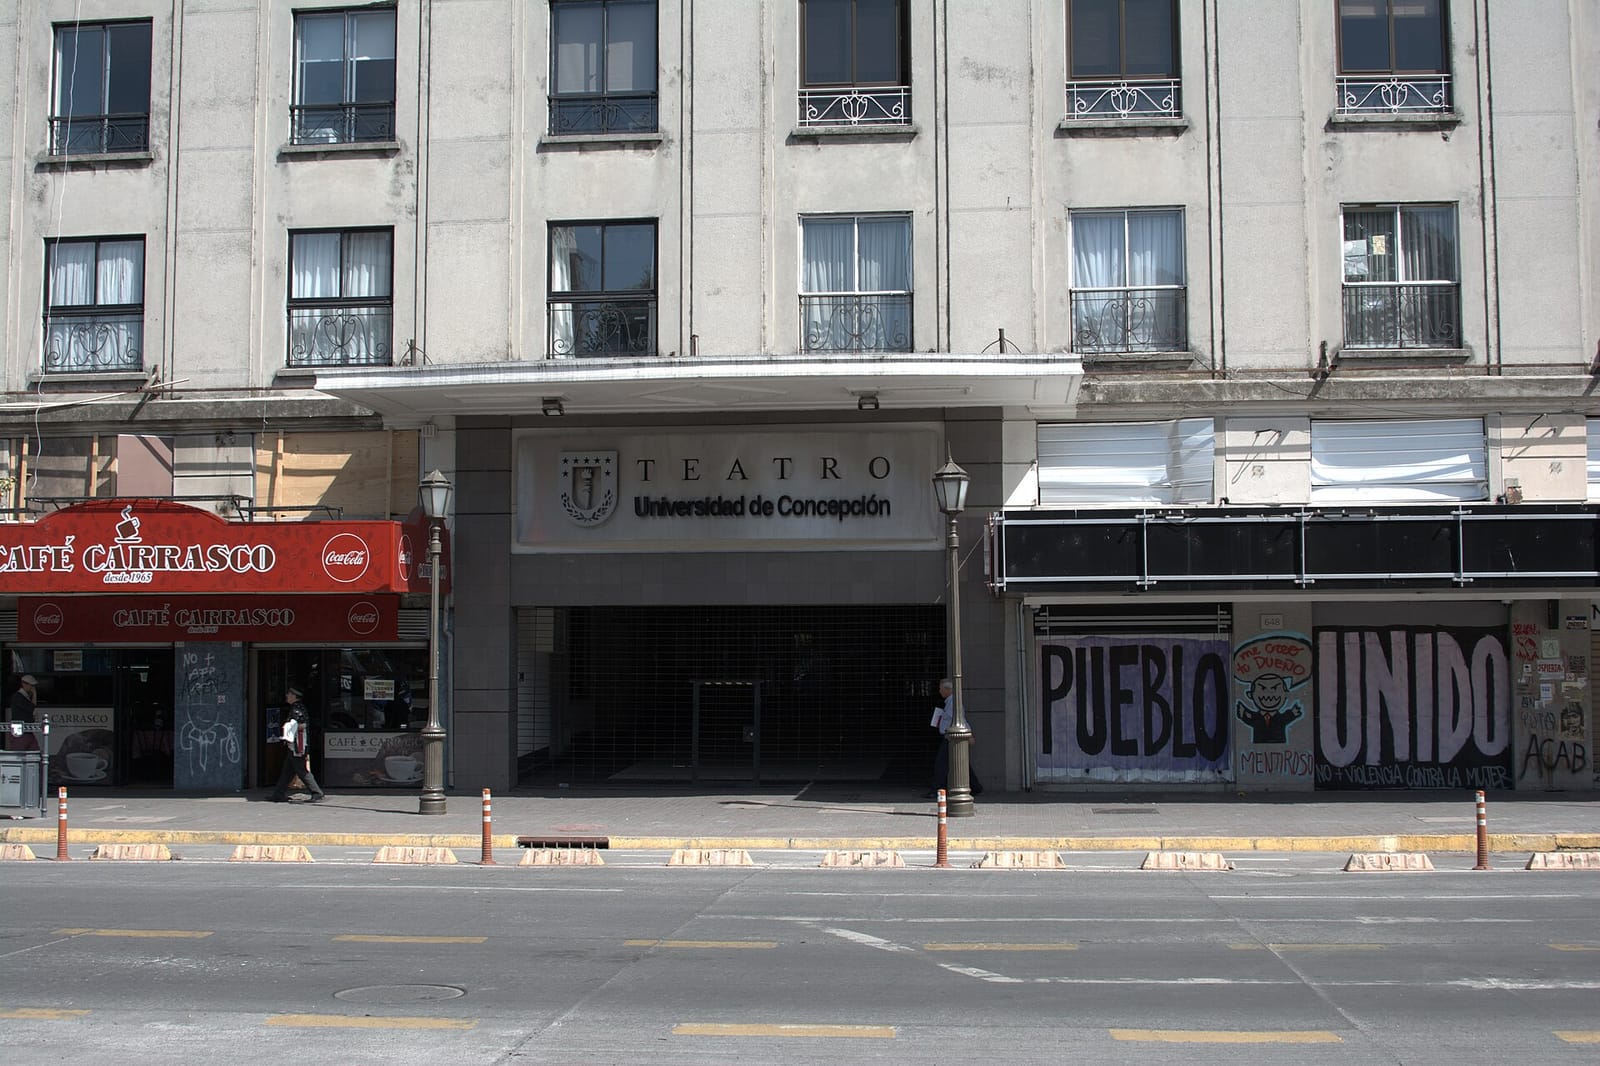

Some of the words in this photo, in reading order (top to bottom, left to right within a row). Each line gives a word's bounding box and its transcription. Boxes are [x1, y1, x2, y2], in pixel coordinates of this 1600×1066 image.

[637, 456, 891, 481] TEATRO
[634, 495, 745, 518] Universidad
[749, 495, 773, 517] de
[777, 494, 891, 523] Concepción
[83, 543, 276, 574] CARRASCO
[103, 572, 129, 584] desde
[130, 572, 152, 583] 1965
[113, 603, 171, 627] CAFÉ
[174, 609, 295, 627] CARRASCO
[183, 653, 198, 667] NO
[1041, 644, 1229, 762] PUEBLO
[1318, 630, 1510, 768] UNIDO
[51, 714, 109, 723] CARRASCO
[328, 736, 357, 748] CAFÉ
[1519, 734, 1586, 780] ACAB
[1315, 764, 1332, 784] NO
[1406, 764, 1445, 787] CONTRA
[1448, 765, 1462, 787] LA
[1465, 764, 1506, 787] MUJER
